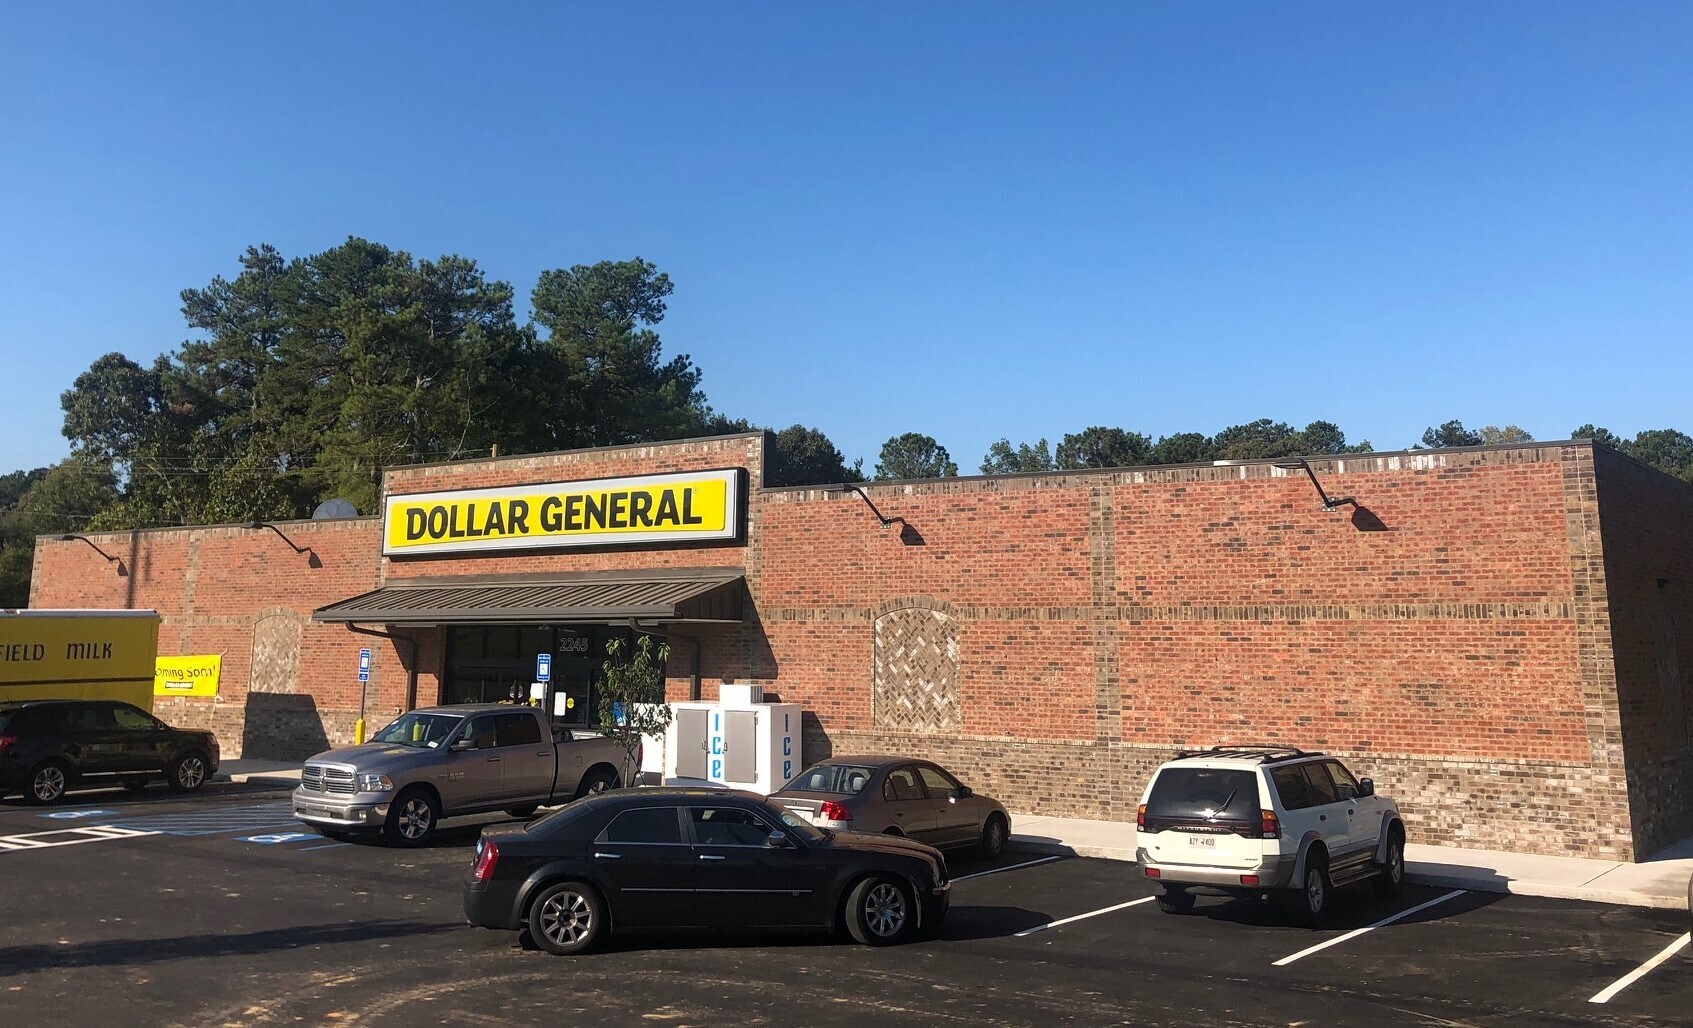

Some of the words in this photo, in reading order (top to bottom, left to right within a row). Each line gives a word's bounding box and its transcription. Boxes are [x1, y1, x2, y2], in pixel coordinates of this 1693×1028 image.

[406, 499, 529, 540] DOLLAR
[540, 487, 703, 532] GENERAL
[66, 642, 112, 660] MILK
[559, 637, 588, 652] 2245
